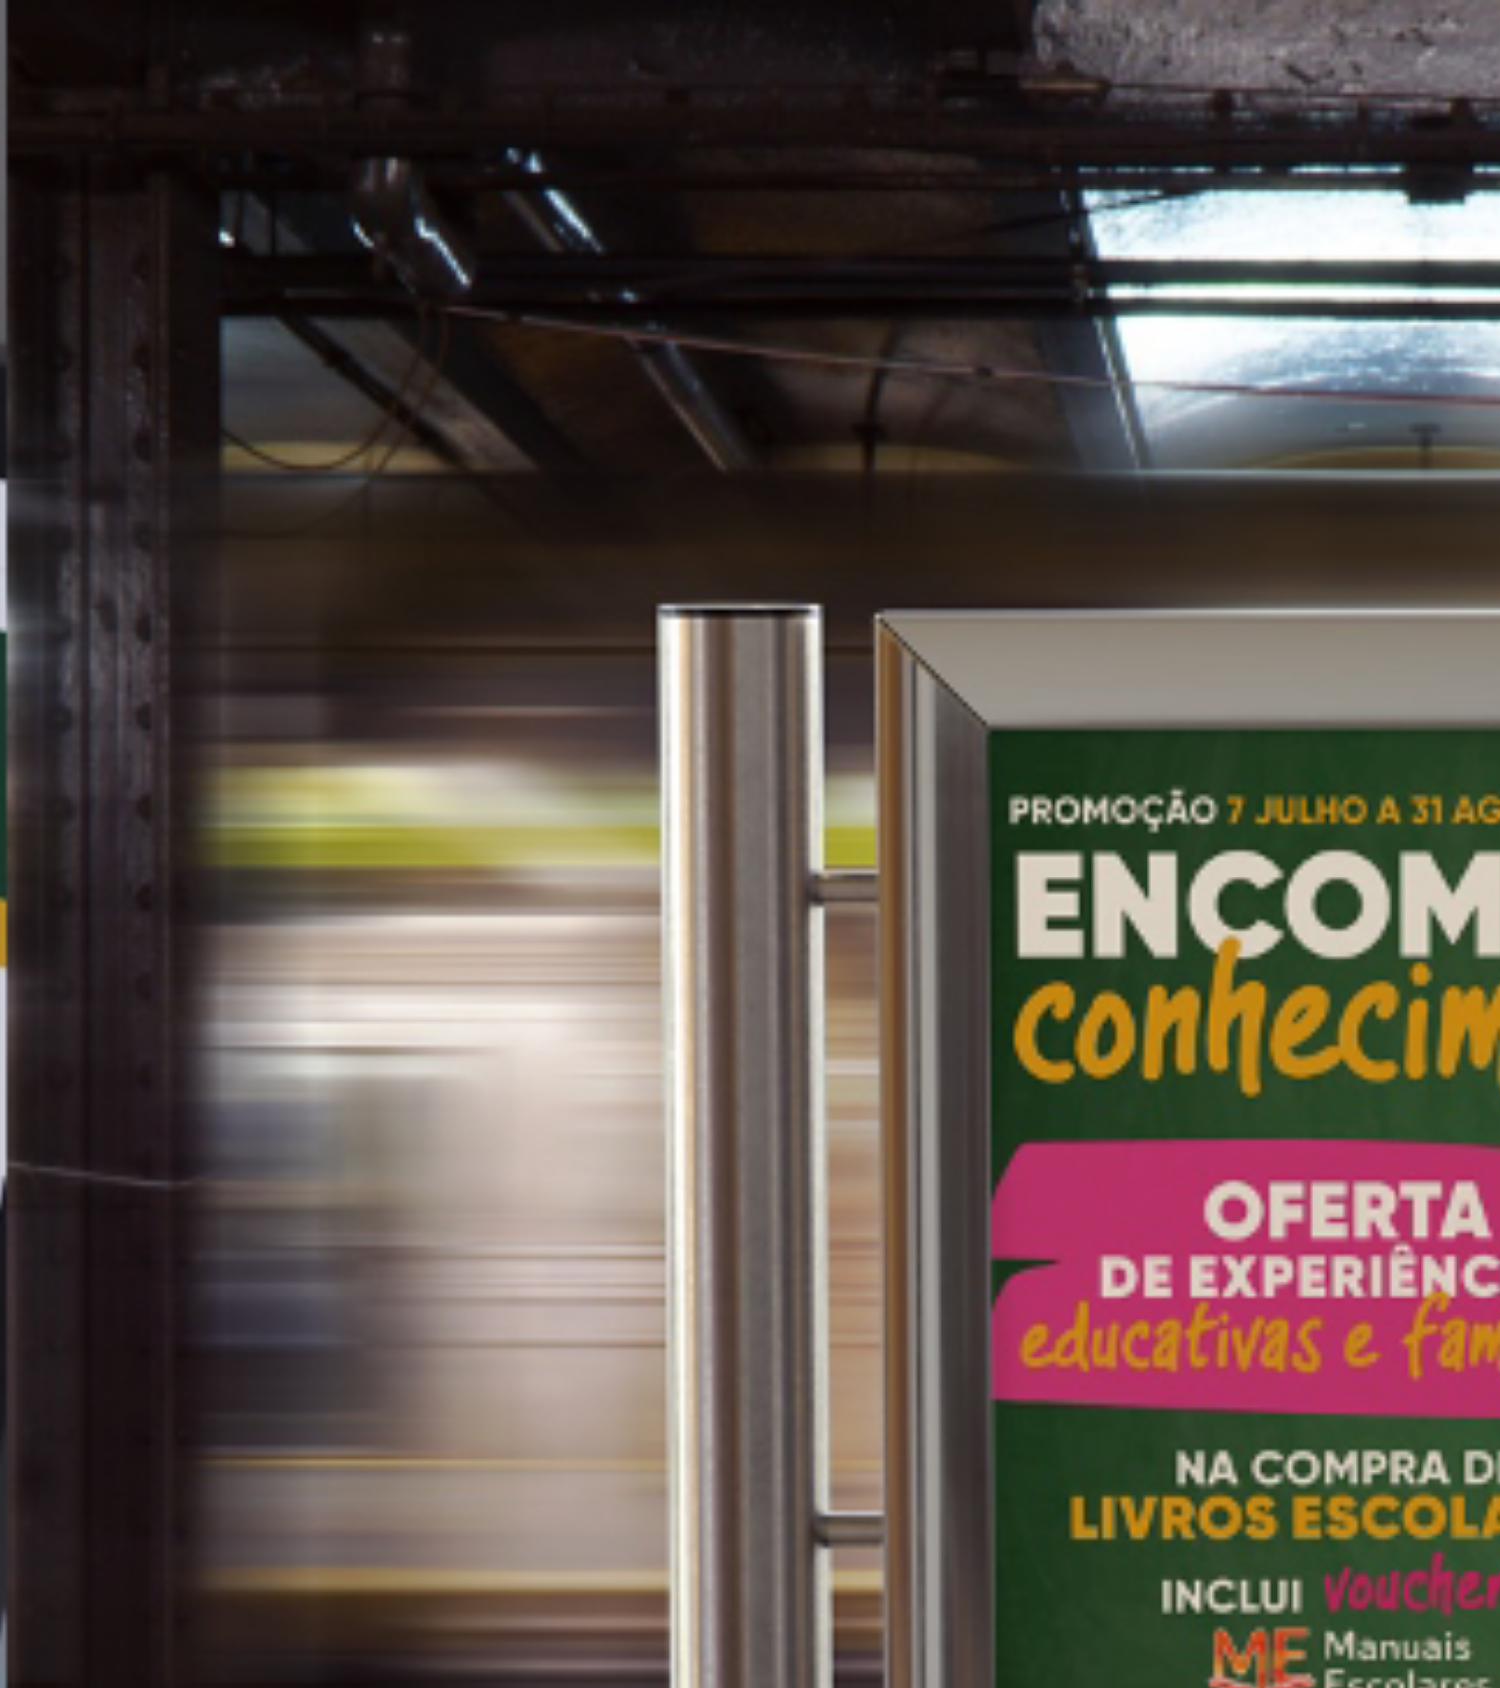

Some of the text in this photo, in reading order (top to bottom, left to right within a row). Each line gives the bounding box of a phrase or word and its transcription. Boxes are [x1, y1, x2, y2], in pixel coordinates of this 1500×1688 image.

[1007, 788, 1218, 833] PROMOÇÃO
[1226, 797, 1249, 826] 7
[1255, 797, 1369, 826] JULHO
[1376, 797, 1403, 826] A
[1410, 797, 1443, 826] 31
[1203, 1179, 1493, 1241] OFERTA
[1100, 1254, 1172, 1298] DE
[1020, 1301, 1322, 1373] educativas
[1344, 1325, 1379, 1367] e
[1175, 1449, 1239, 1486] NA
[1250, 1449, 1450, 1486] COMPRA
[1069, 1494, 1280, 1541] LIVROS
[1161, 1578, 1302, 1614] INCLUI
[1323, 1630, 1471, 1661] Manuais
